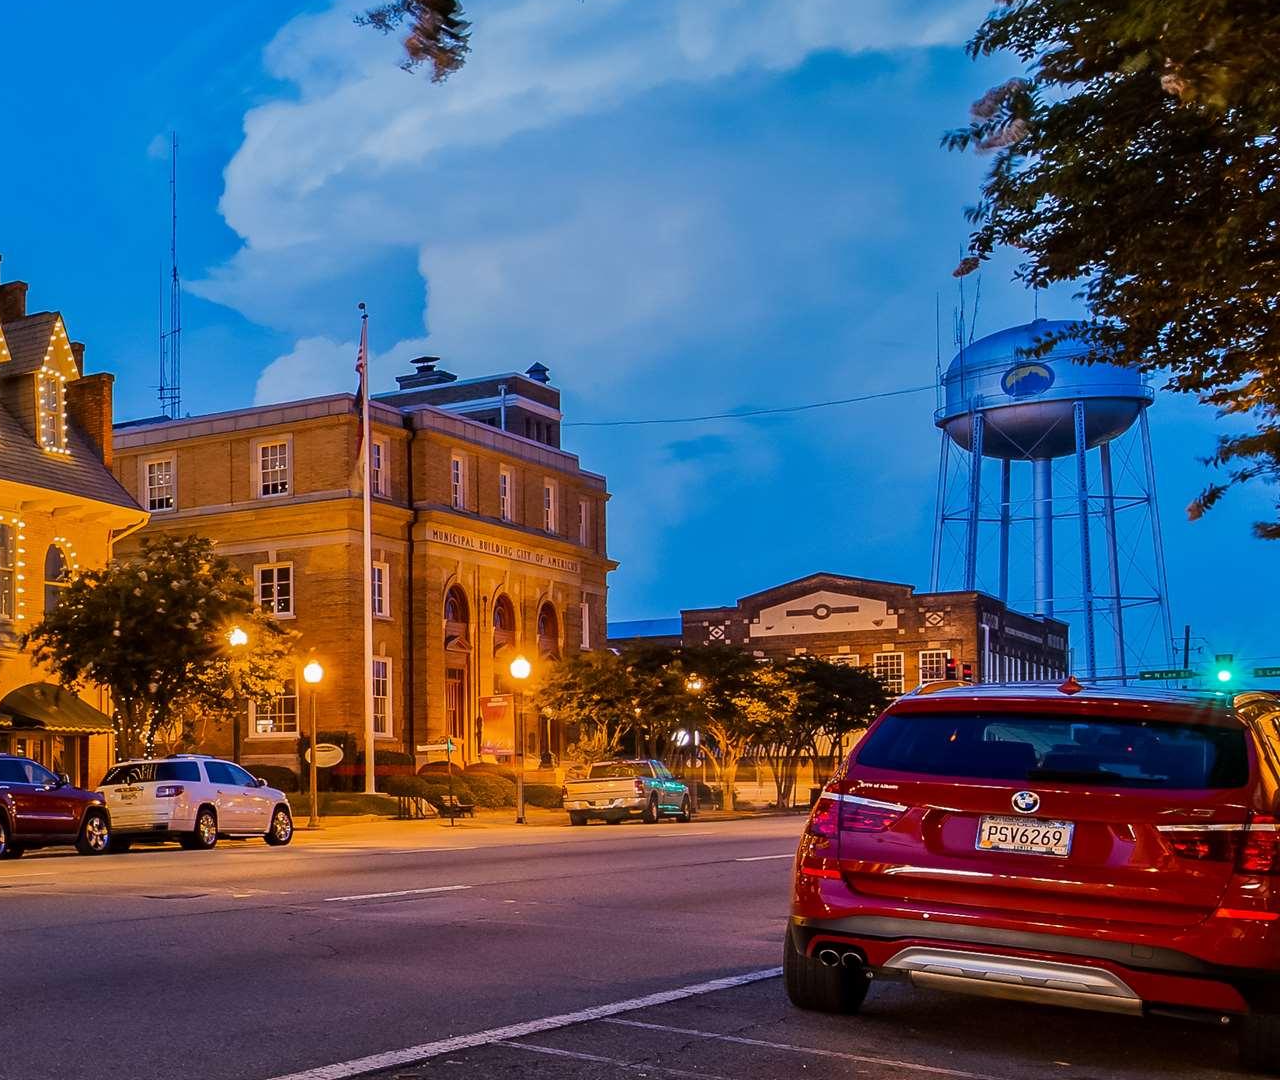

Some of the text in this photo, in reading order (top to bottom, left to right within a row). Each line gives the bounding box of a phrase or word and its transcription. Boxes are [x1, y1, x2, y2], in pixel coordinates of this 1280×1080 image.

[432, 529, 579, 572] MUNICIPAL BUILDING CITY OF AMERICUS
[987, 825, 1062, 847] PSV6269
